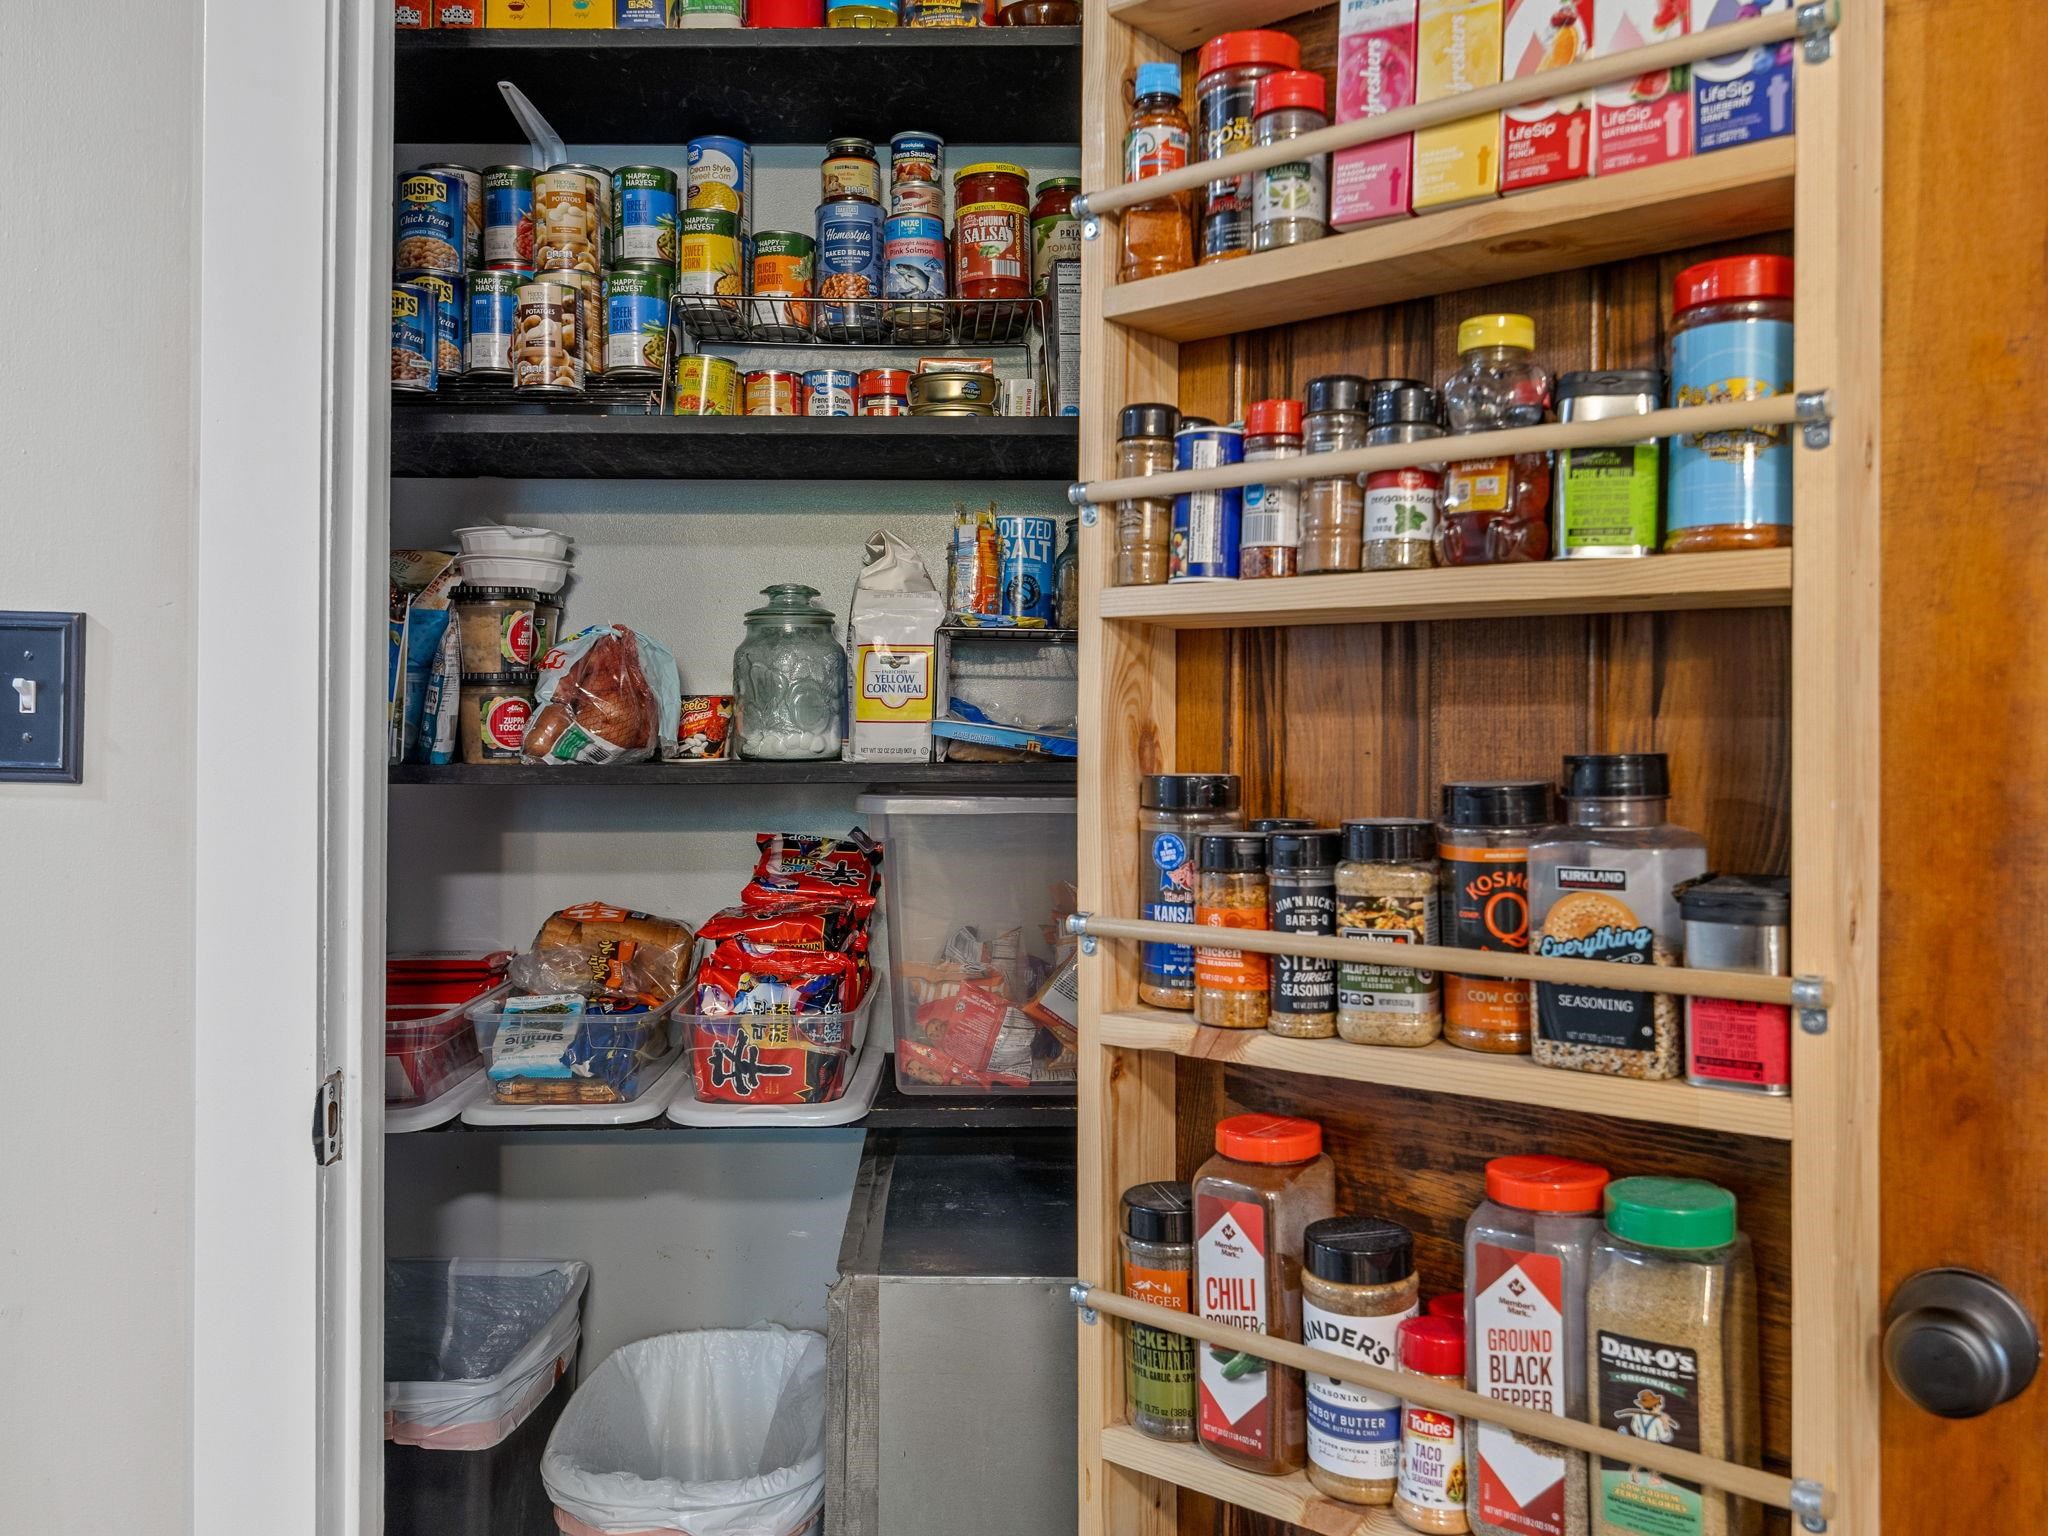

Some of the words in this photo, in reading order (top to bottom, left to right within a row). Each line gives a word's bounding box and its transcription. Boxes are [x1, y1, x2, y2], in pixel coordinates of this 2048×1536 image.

[1700, 80, 1755, 104] LifeSip
[1601, 106, 1650, 127] LifeSip
[1508, 121, 1556, 141] LifeSip
[1602, 118, 1662, 139] WATERMELON
[911, 150, 937, 160] Sausage
[713, 163, 731, 174] Style
[996, 164, 1016, 172] MEDIUM
[403, 182, 445, 200] BUSH'S
[551, 196, 581, 204] POTATOES
[401, 213, 424, 227] Chick
[426, 214, 450, 229] Peas
[684, 223, 715, 231] HARVEST
[978, 216, 1008, 227] CHUNKY
[826, 228, 872, 243] Homestyle
[964, 227, 1009, 245] SALSA
[757, 245, 785, 253] HARVEST
[760, 239, 779, 247] HAPPY
[684, 245, 704, 257] SWEET
[826, 249, 846, 258] BAKED
[848, 249, 870, 257] BEANS
[684, 258, 700, 269] CORN
[611, 285, 643, 293] HARVEST
[614, 278, 636, 286] HAPPY
[403, 330, 425, 345] Peas
[834, 395, 851, 404] Onion
[875, 674, 914, 684] YELLOW
[867, 684, 895, 693] CORN
[898, 684, 923, 694] MEAL
[503, 717, 524, 725] ZUPPA
[1559, 870, 1625, 884] KIRKLAND
[1285, 914, 1329, 926] BAR-B-Q
[1540, 926, 1652, 957] Everything
[1282, 973, 1290, 981] &
[1292, 972, 1333, 983] BURGER
[1382, 966, 1415, 977] POPPER
[1281, 984, 1334, 997] SEASONING
[1467, 990, 1498, 1003] COW
[1558, 994, 1634, 1013] SEASONING
[1214, 1240, 1244, 1253] Member's
[1206, 1277, 1256, 1311] CHILI
[1498, 1297, 1536, 1311] Member's
[1488, 1328, 1552, 1353] GROUND
[1600, 1336, 1695, 1373] DAN-O'S
[1490, 1354, 1553, 1386] BLACK
[1615, 1360, 1678, 1379] SEASONING
[1620, 1374, 1672, 1391] ORIGINAL
[1312, 1383, 1368, 1403] SEASONING
[1340, 1415, 1386, 1429] BUTTER
[1410, 1413, 1451, 1437] Tone's
[1332, 1425, 1355, 1435] BUTTER
[1415, 1442, 1442, 1462] TACO
[1412, 1457, 1444, 1478] NIGHT
[1412, 1472, 1443, 1487] SEASONING
